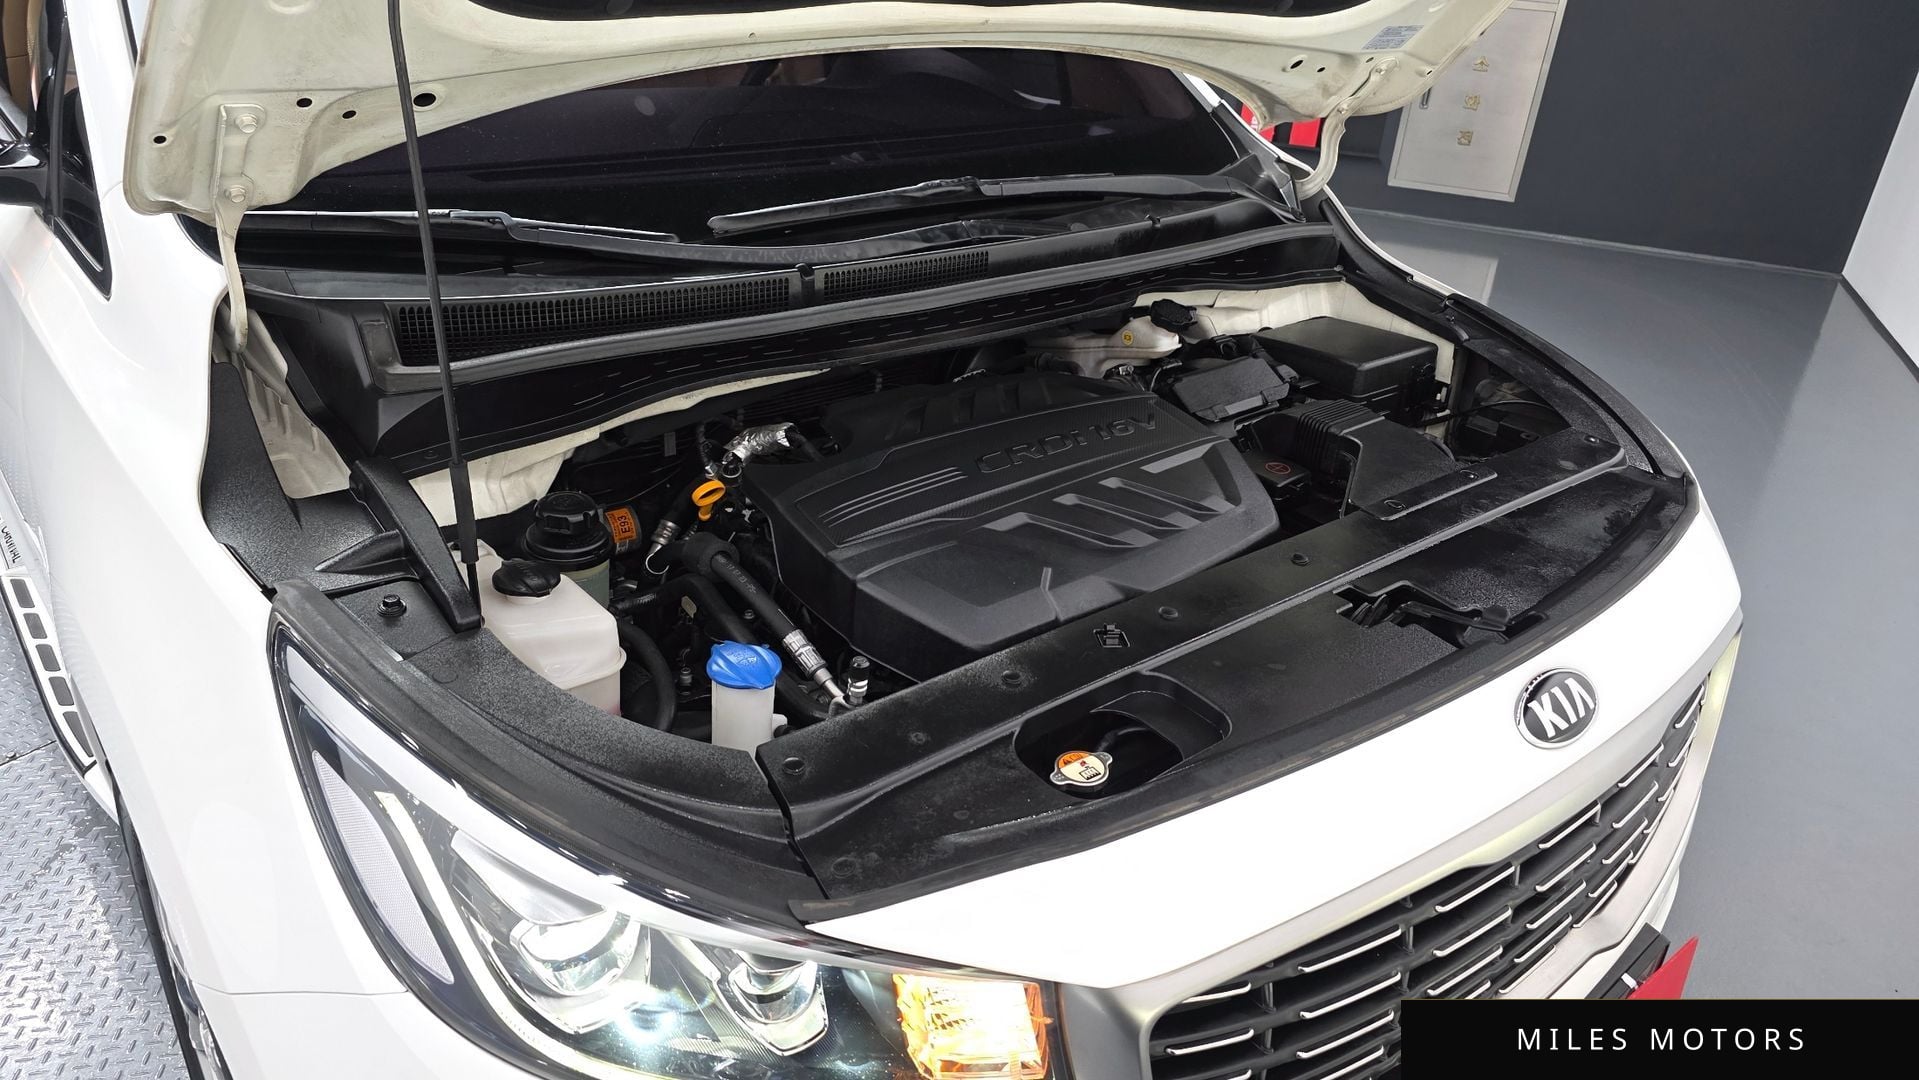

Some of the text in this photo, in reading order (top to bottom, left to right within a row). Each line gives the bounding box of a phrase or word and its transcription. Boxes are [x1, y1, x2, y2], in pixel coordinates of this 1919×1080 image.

[1457, 55, 1489, 147] 소화전
[1088, 413, 1156, 441] 16V
[617, 515, 631, 534] E93
[1527, 677, 1595, 739] KIA
